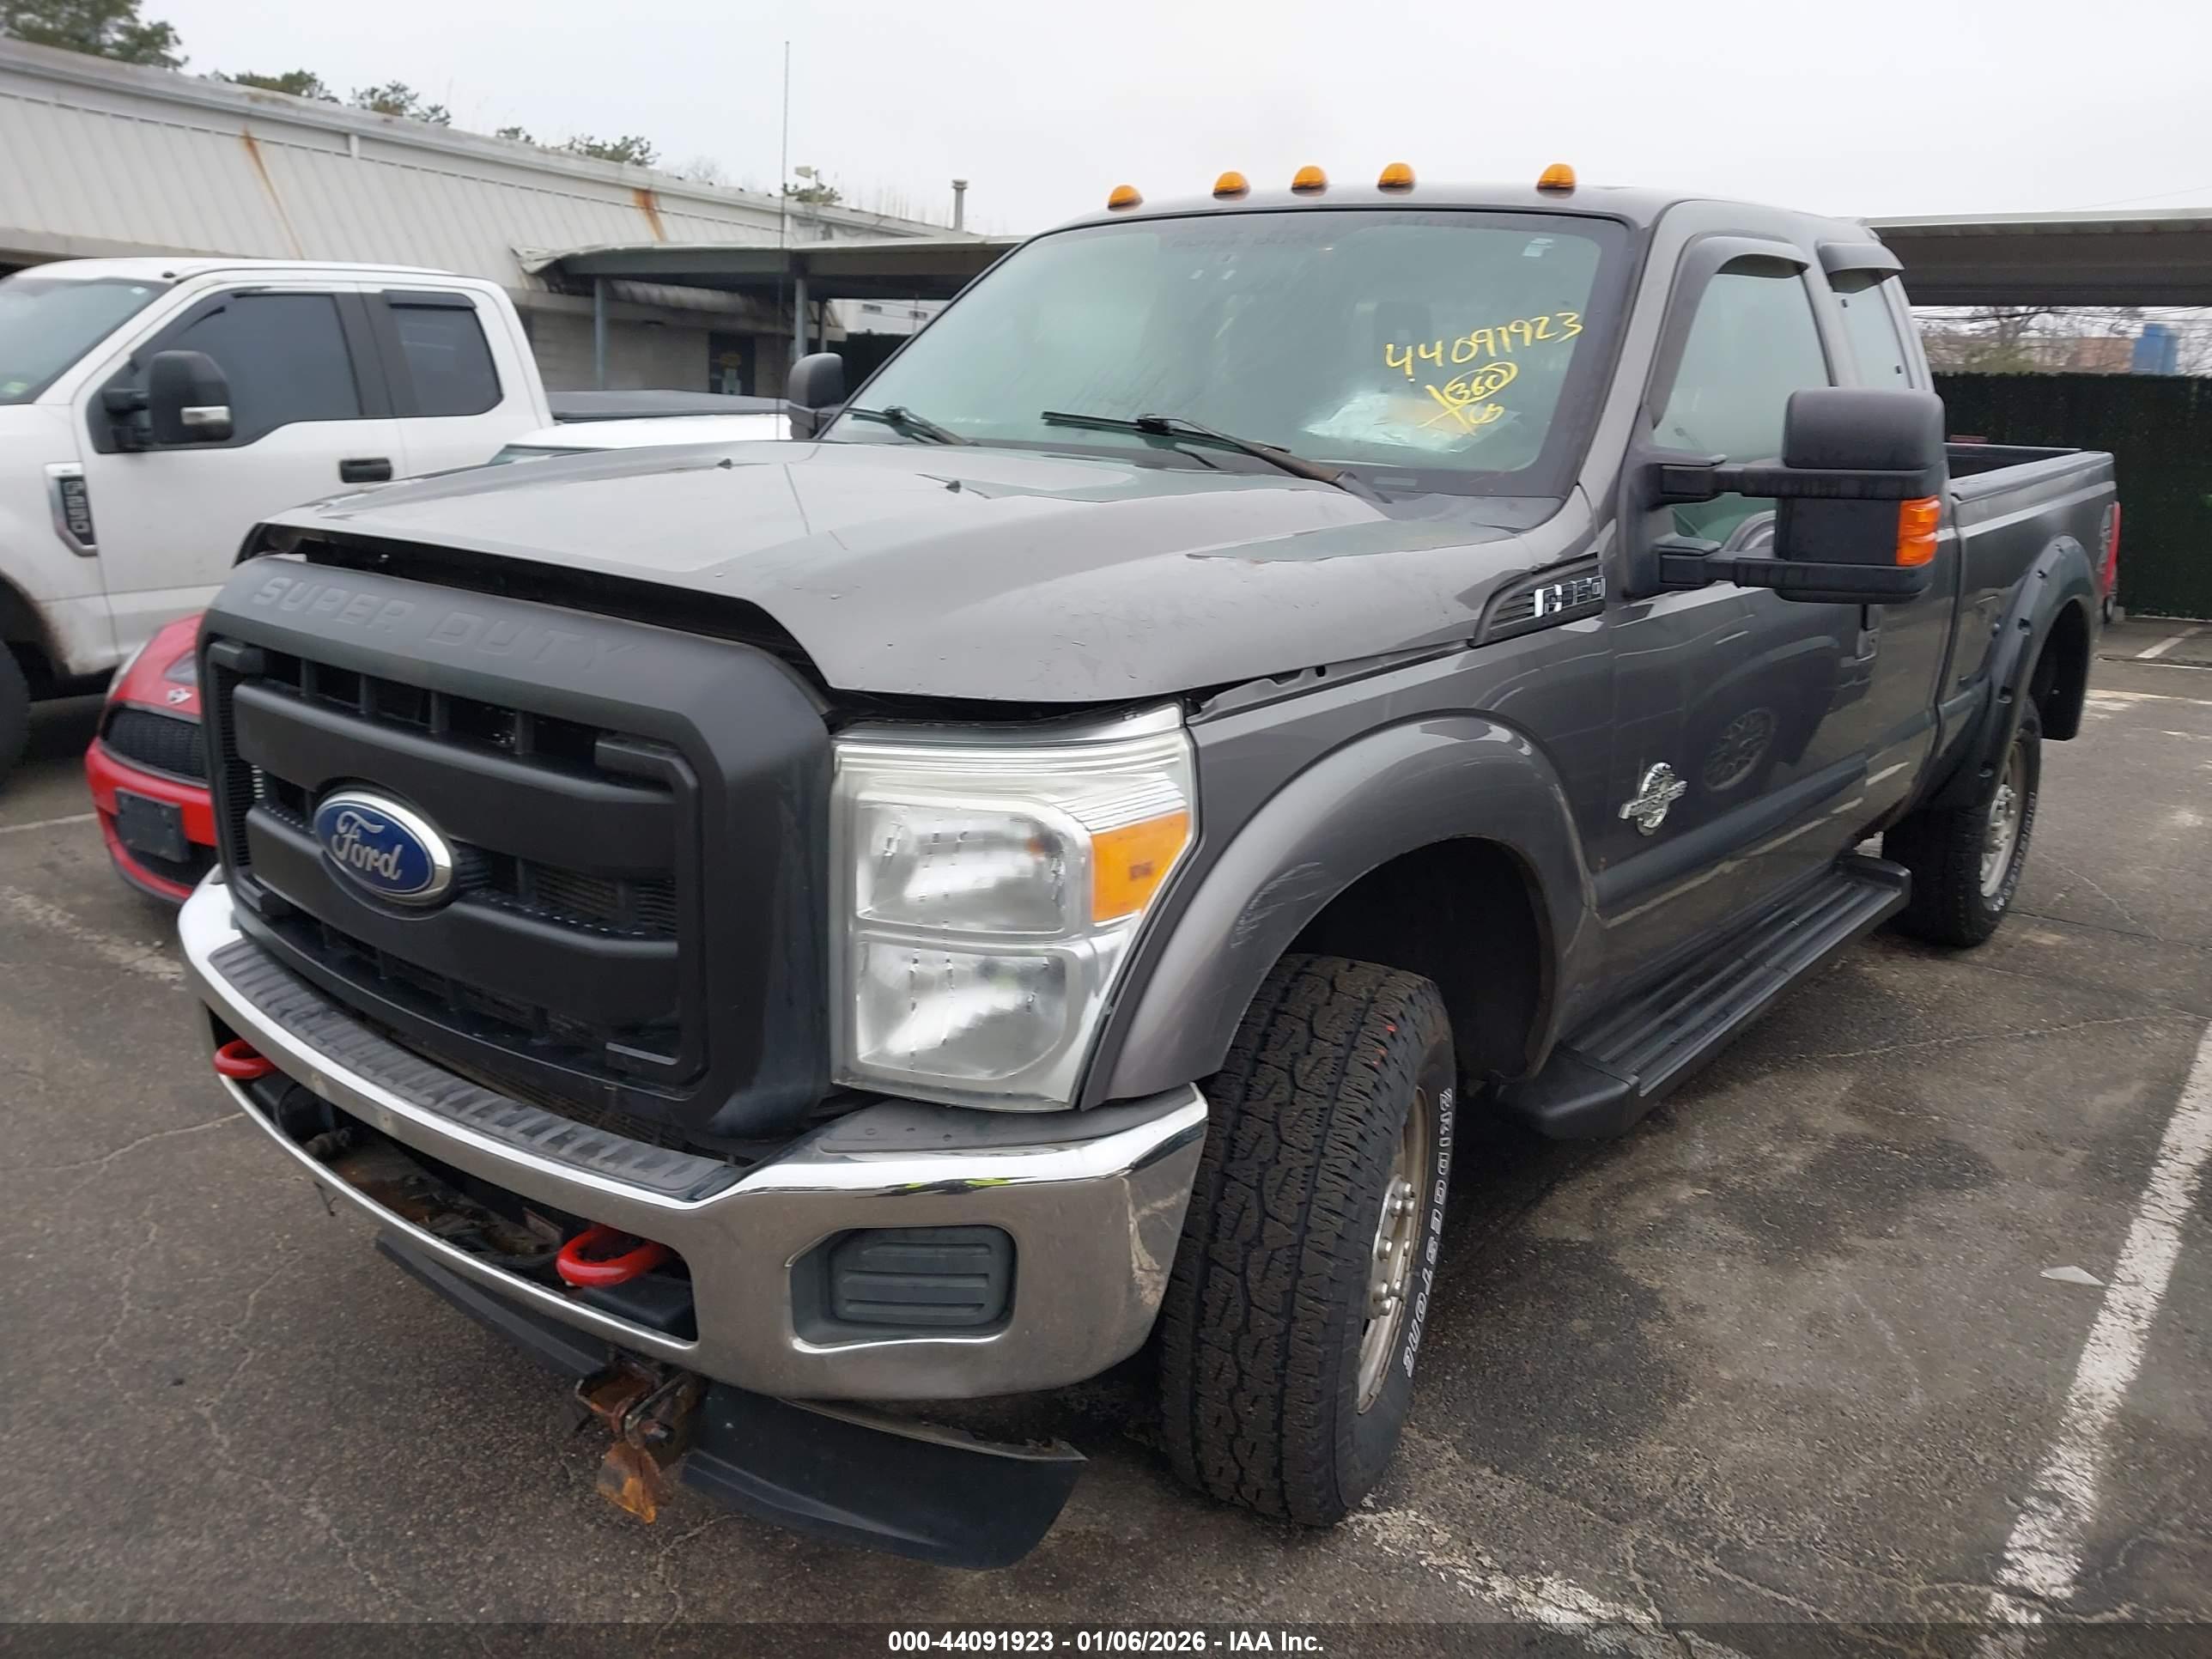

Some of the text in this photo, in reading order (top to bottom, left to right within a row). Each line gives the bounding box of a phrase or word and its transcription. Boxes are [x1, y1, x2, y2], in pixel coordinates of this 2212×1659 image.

[1384, 312, 1583, 378] 44091923
[255, 576, 643, 674] SUPER DUTY
[331, 811, 403, 880] Ford
[1402, 1087, 1453, 1377] BRIDGESTONE
